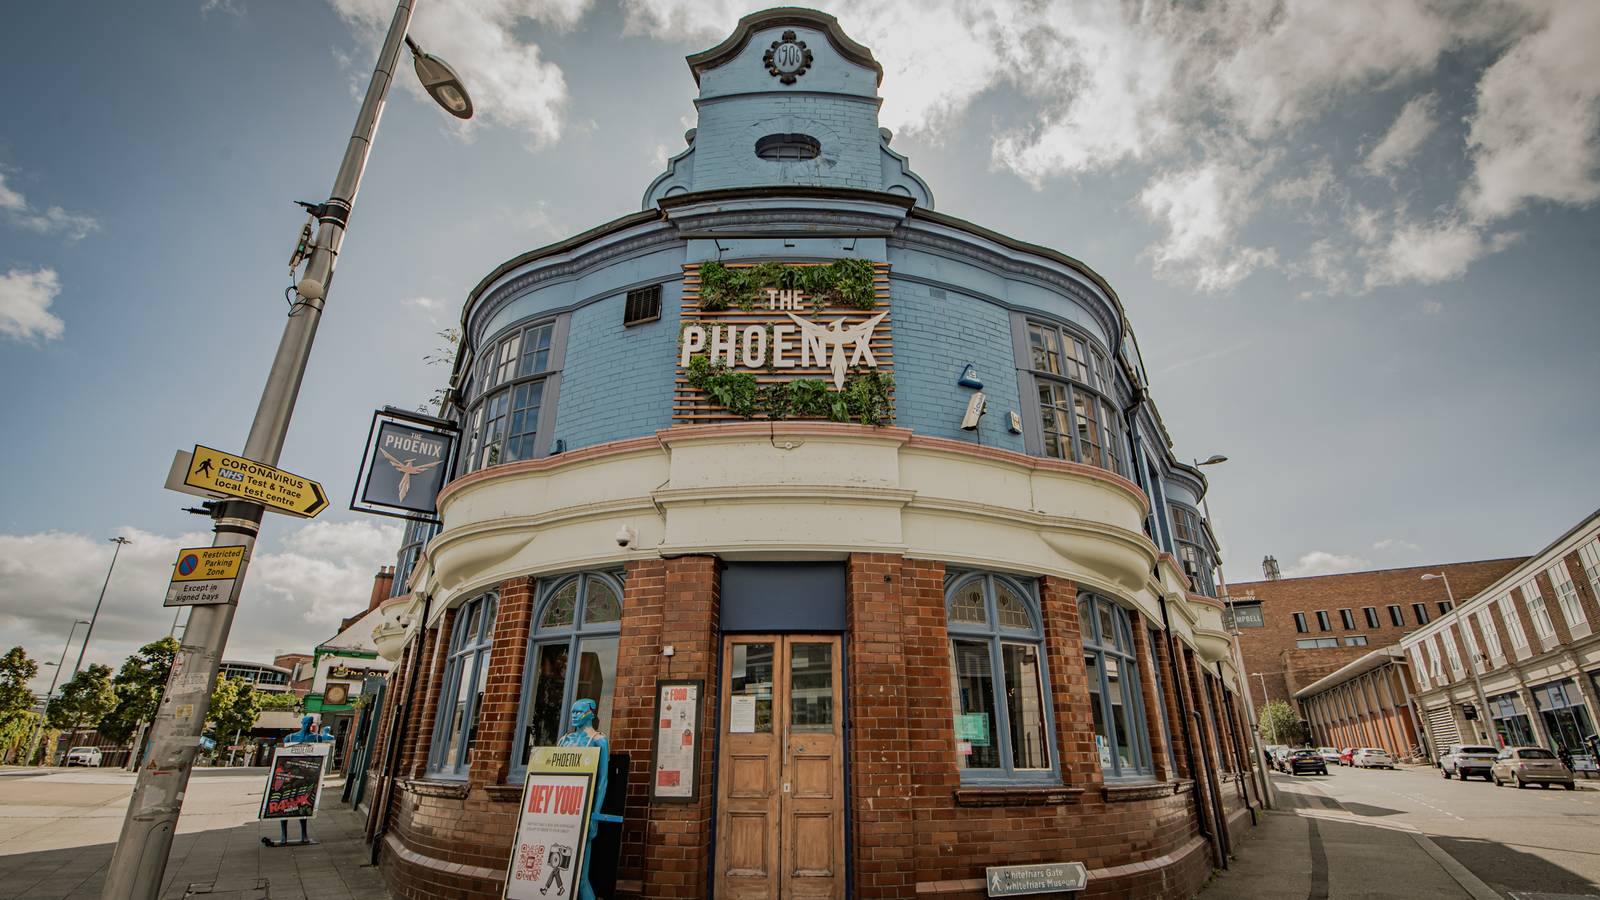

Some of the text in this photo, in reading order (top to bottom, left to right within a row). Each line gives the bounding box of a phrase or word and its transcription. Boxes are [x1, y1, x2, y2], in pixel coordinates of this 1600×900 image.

[778, 45, 800, 66] 1906
[767, 289, 804, 311] THE
[411, 432, 423, 441] THE
[385, 434, 442, 458] PHOENIX
[221, 458, 304, 489] CORONAVIRUS
[215, 478, 295, 507] local test centre
[219, 468, 302, 499] NHS Test & Trace
[202, 550, 241, 558] Restricted
[206, 568, 225, 576] Zone
[183, 584, 209, 592] Except
[176, 593, 219, 602] signed bays
[551, 752, 582, 768] PHOENIX
[528, 784, 584, 816] HEY YOU!
[1045, 868, 1064, 877] Gate
